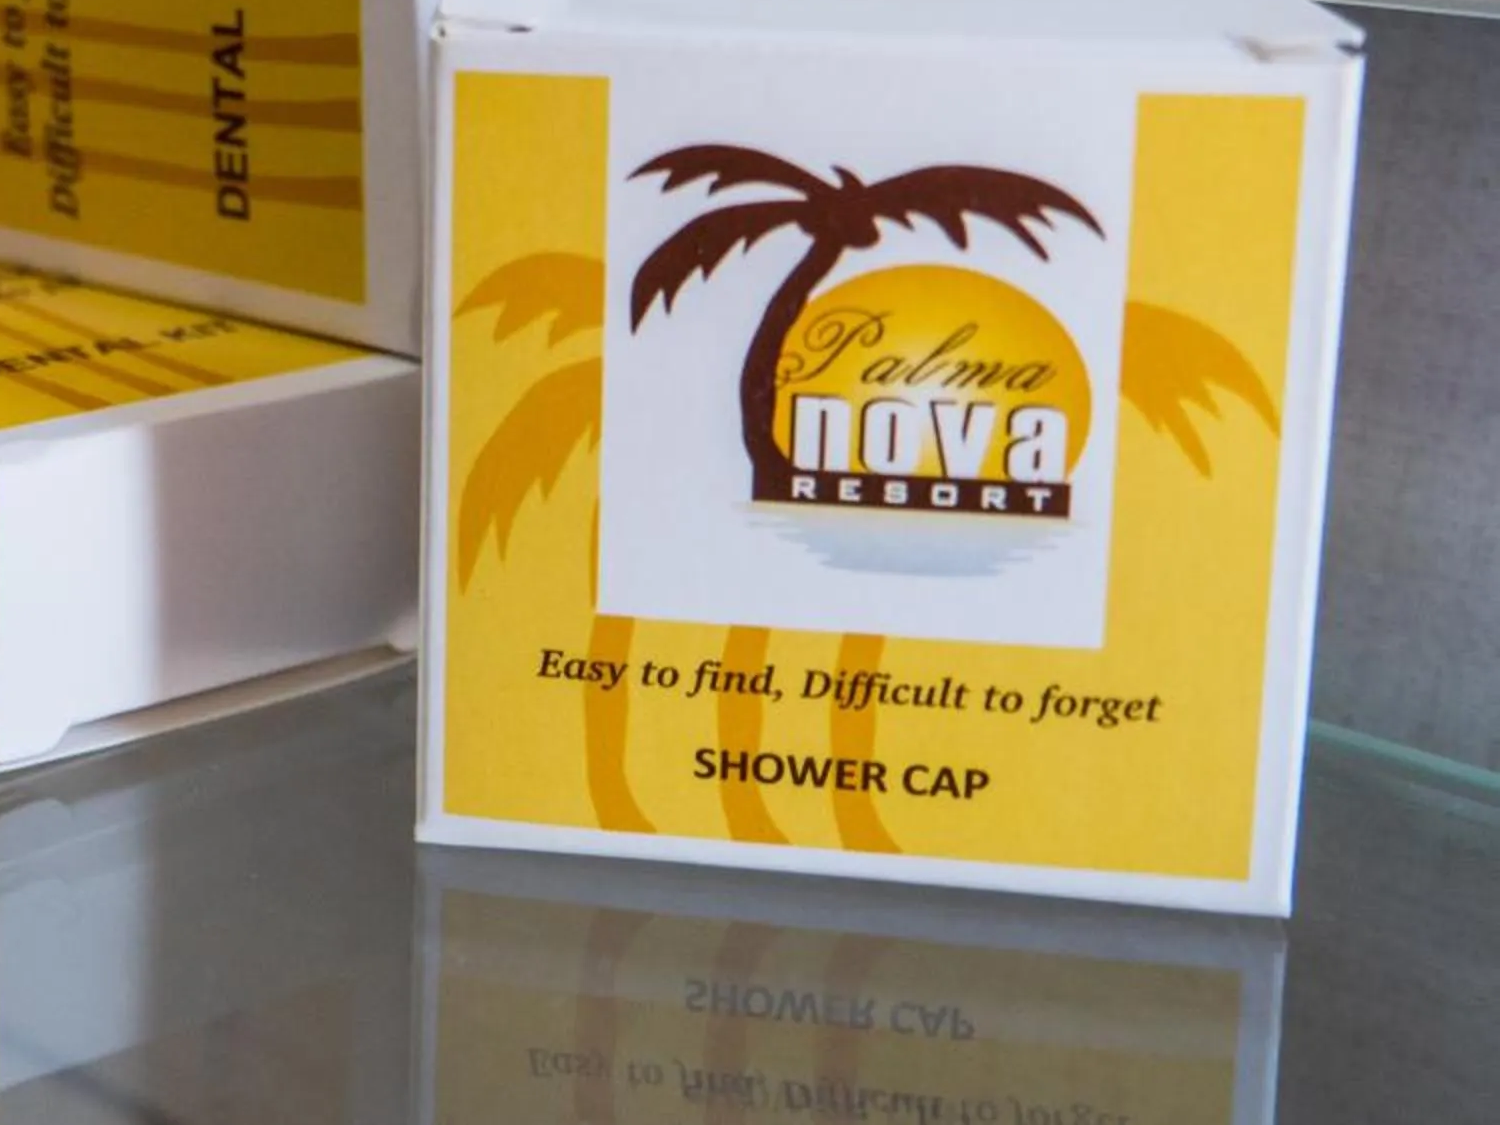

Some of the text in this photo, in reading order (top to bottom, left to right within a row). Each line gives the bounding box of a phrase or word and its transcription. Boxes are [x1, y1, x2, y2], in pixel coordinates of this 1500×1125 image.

[2, 5, 28, 49] to
[2, 60, 36, 159] Easy
[41, 41, 84, 221] Difficult
[211, 8, 251, 221] DENTAL
[775, 306, 1058, 393] Palma
[789, 392, 1070, 483] nova
[791, 475, 1053, 513] RESORT
[537, 648, 1162, 729] Easy to find, Difficult to forget
[693, 747, 990, 800] SHOWER CAP
